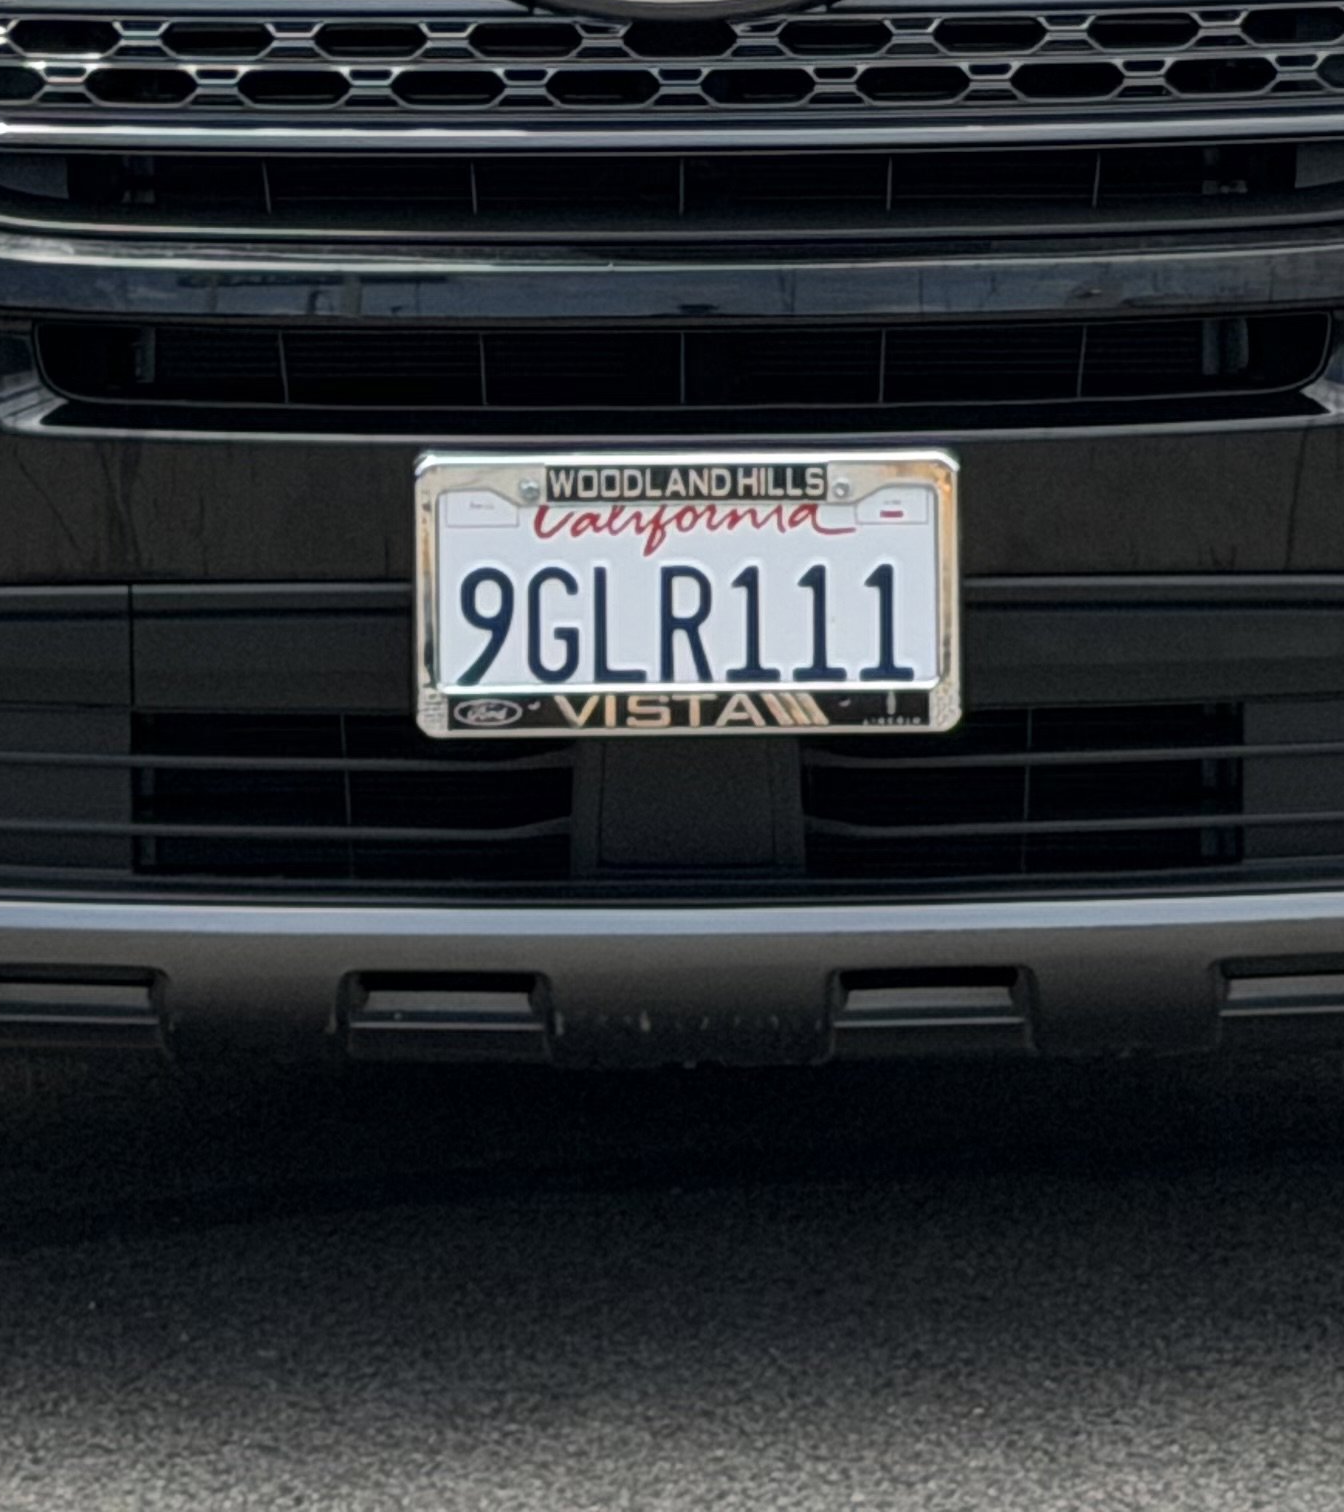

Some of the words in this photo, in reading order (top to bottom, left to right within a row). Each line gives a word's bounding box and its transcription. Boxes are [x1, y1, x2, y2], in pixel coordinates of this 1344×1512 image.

[548, 467, 732, 499] WOODLAND
[737, 466, 827, 498] HILLS
[457, 563, 916, 687] 9GLR111
[555, 692, 768, 729] VISTA
